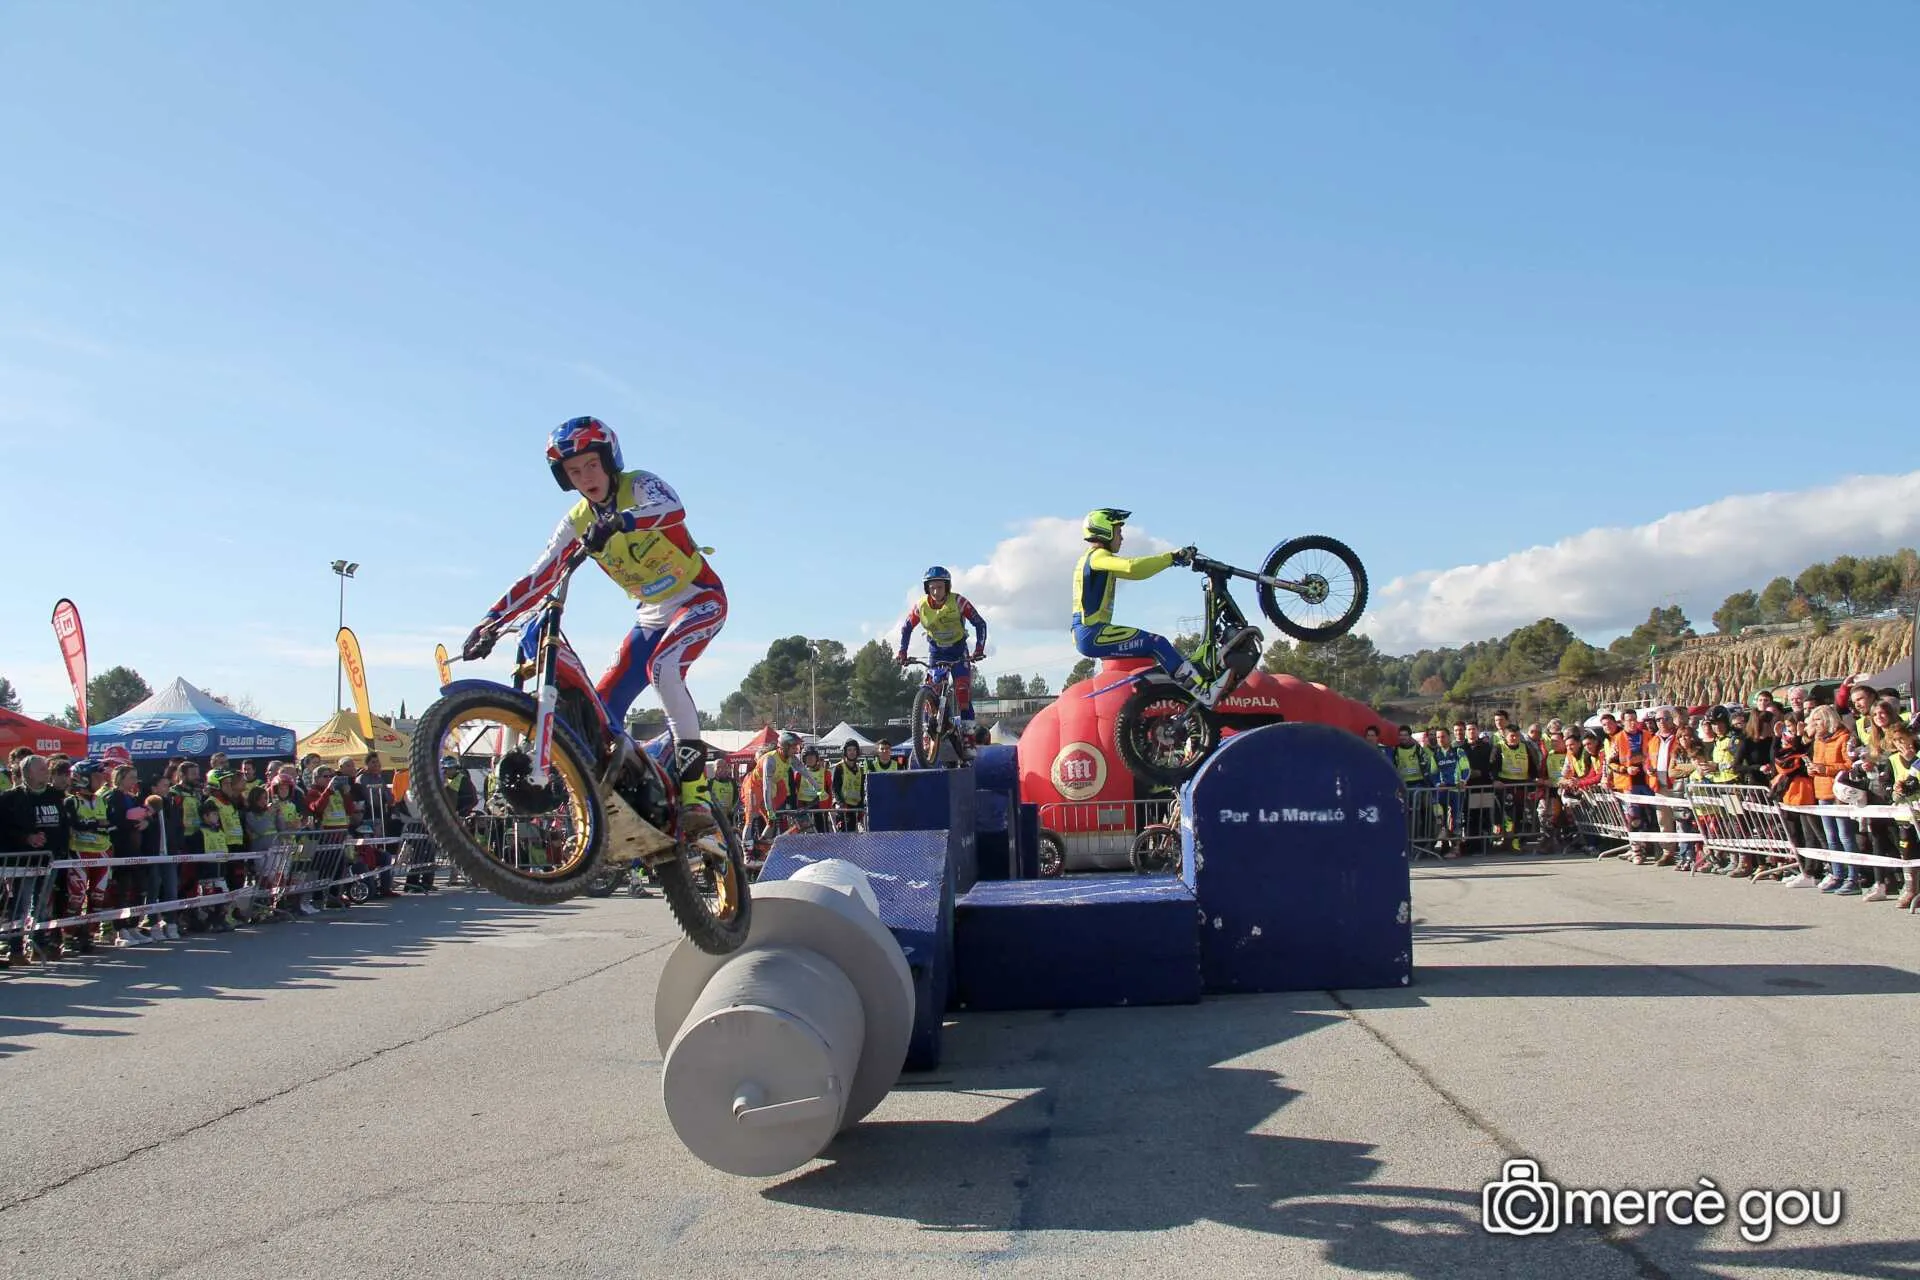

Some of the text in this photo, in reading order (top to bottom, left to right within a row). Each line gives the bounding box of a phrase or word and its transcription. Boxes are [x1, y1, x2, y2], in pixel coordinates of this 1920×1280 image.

[1118, 639, 1144, 651] KENNY
[1225, 695, 1280, 708] IMPALA
[130, 739, 174, 751] Gear
[256, 734, 279, 746] Gear
[1219, 809, 1250, 823] Por
